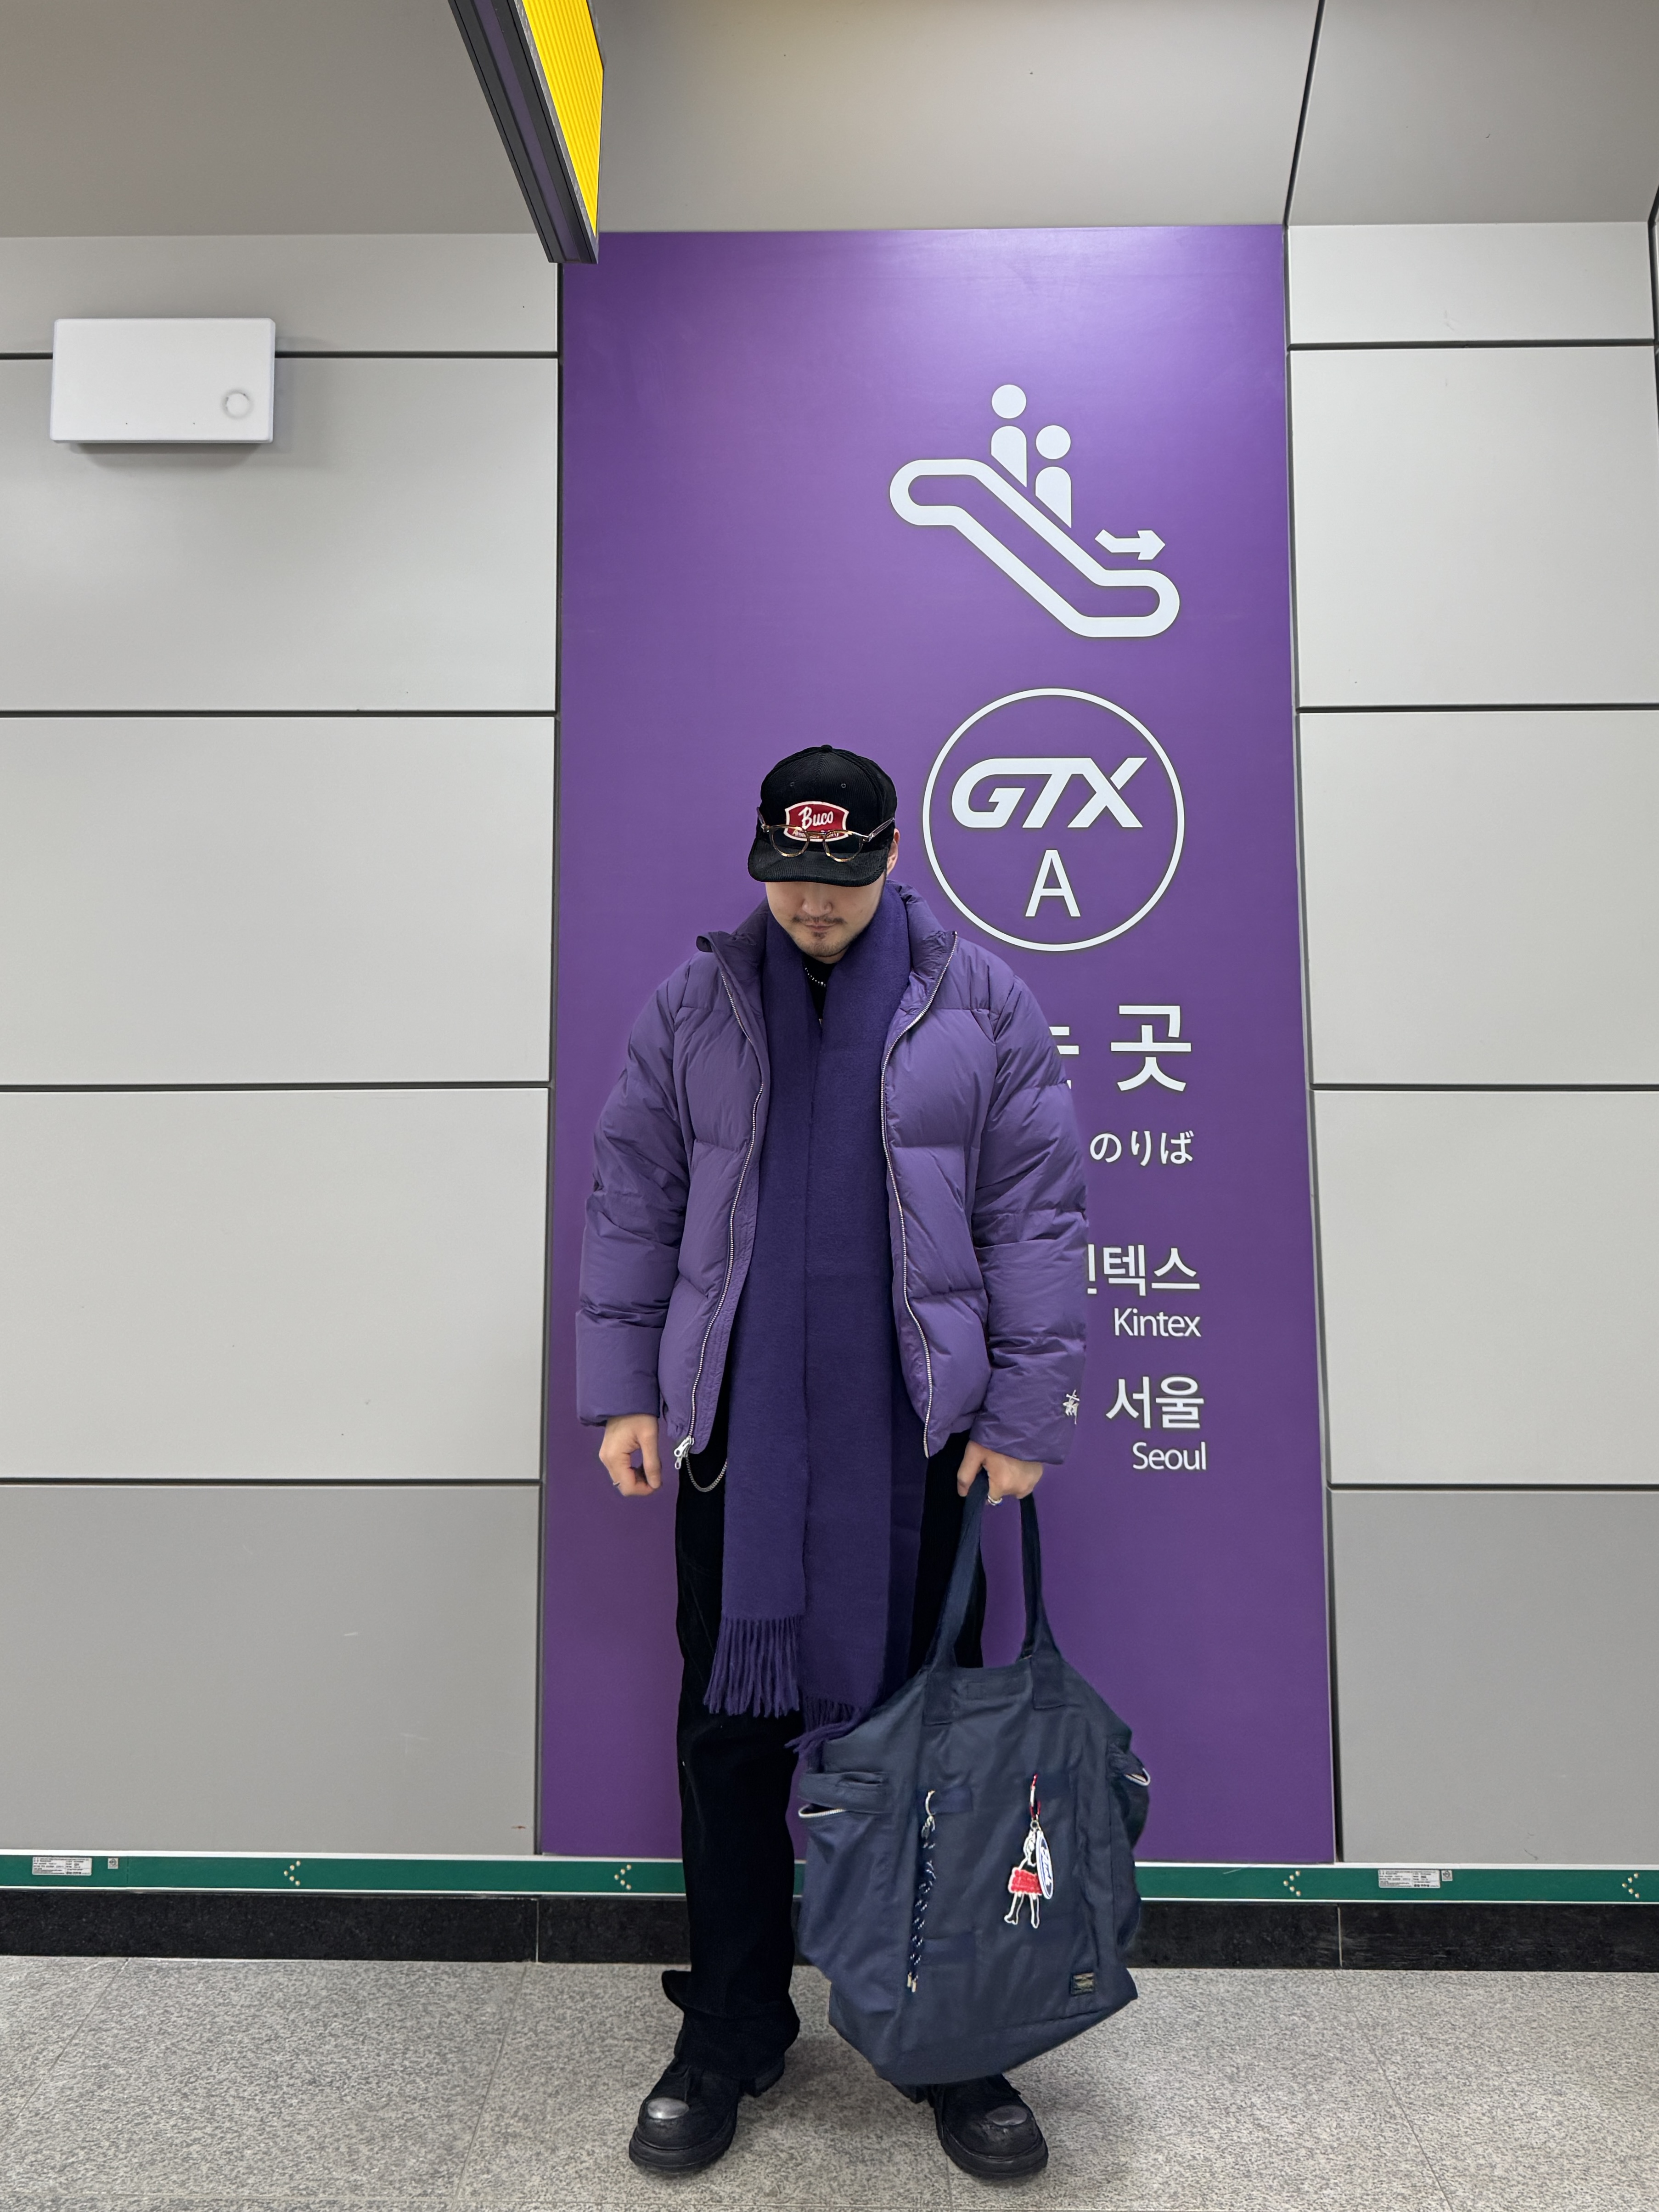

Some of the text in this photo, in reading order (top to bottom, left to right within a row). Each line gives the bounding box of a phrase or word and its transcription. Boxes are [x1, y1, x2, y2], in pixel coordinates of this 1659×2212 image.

[951, 757, 1147, 828] GTX
[798, 806, 834, 830] Buco
[1025, 849, 1081, 917] A
[1110, 1005, 1192, 1092] 곳
[1090, 1130, 1194, 1167] のりば
[1114, 1307, 1202, 1337] Kintex
[1105, 1376, 1205, 1429] 서울
[1132, 1441, 1207, 1470] Seoul
